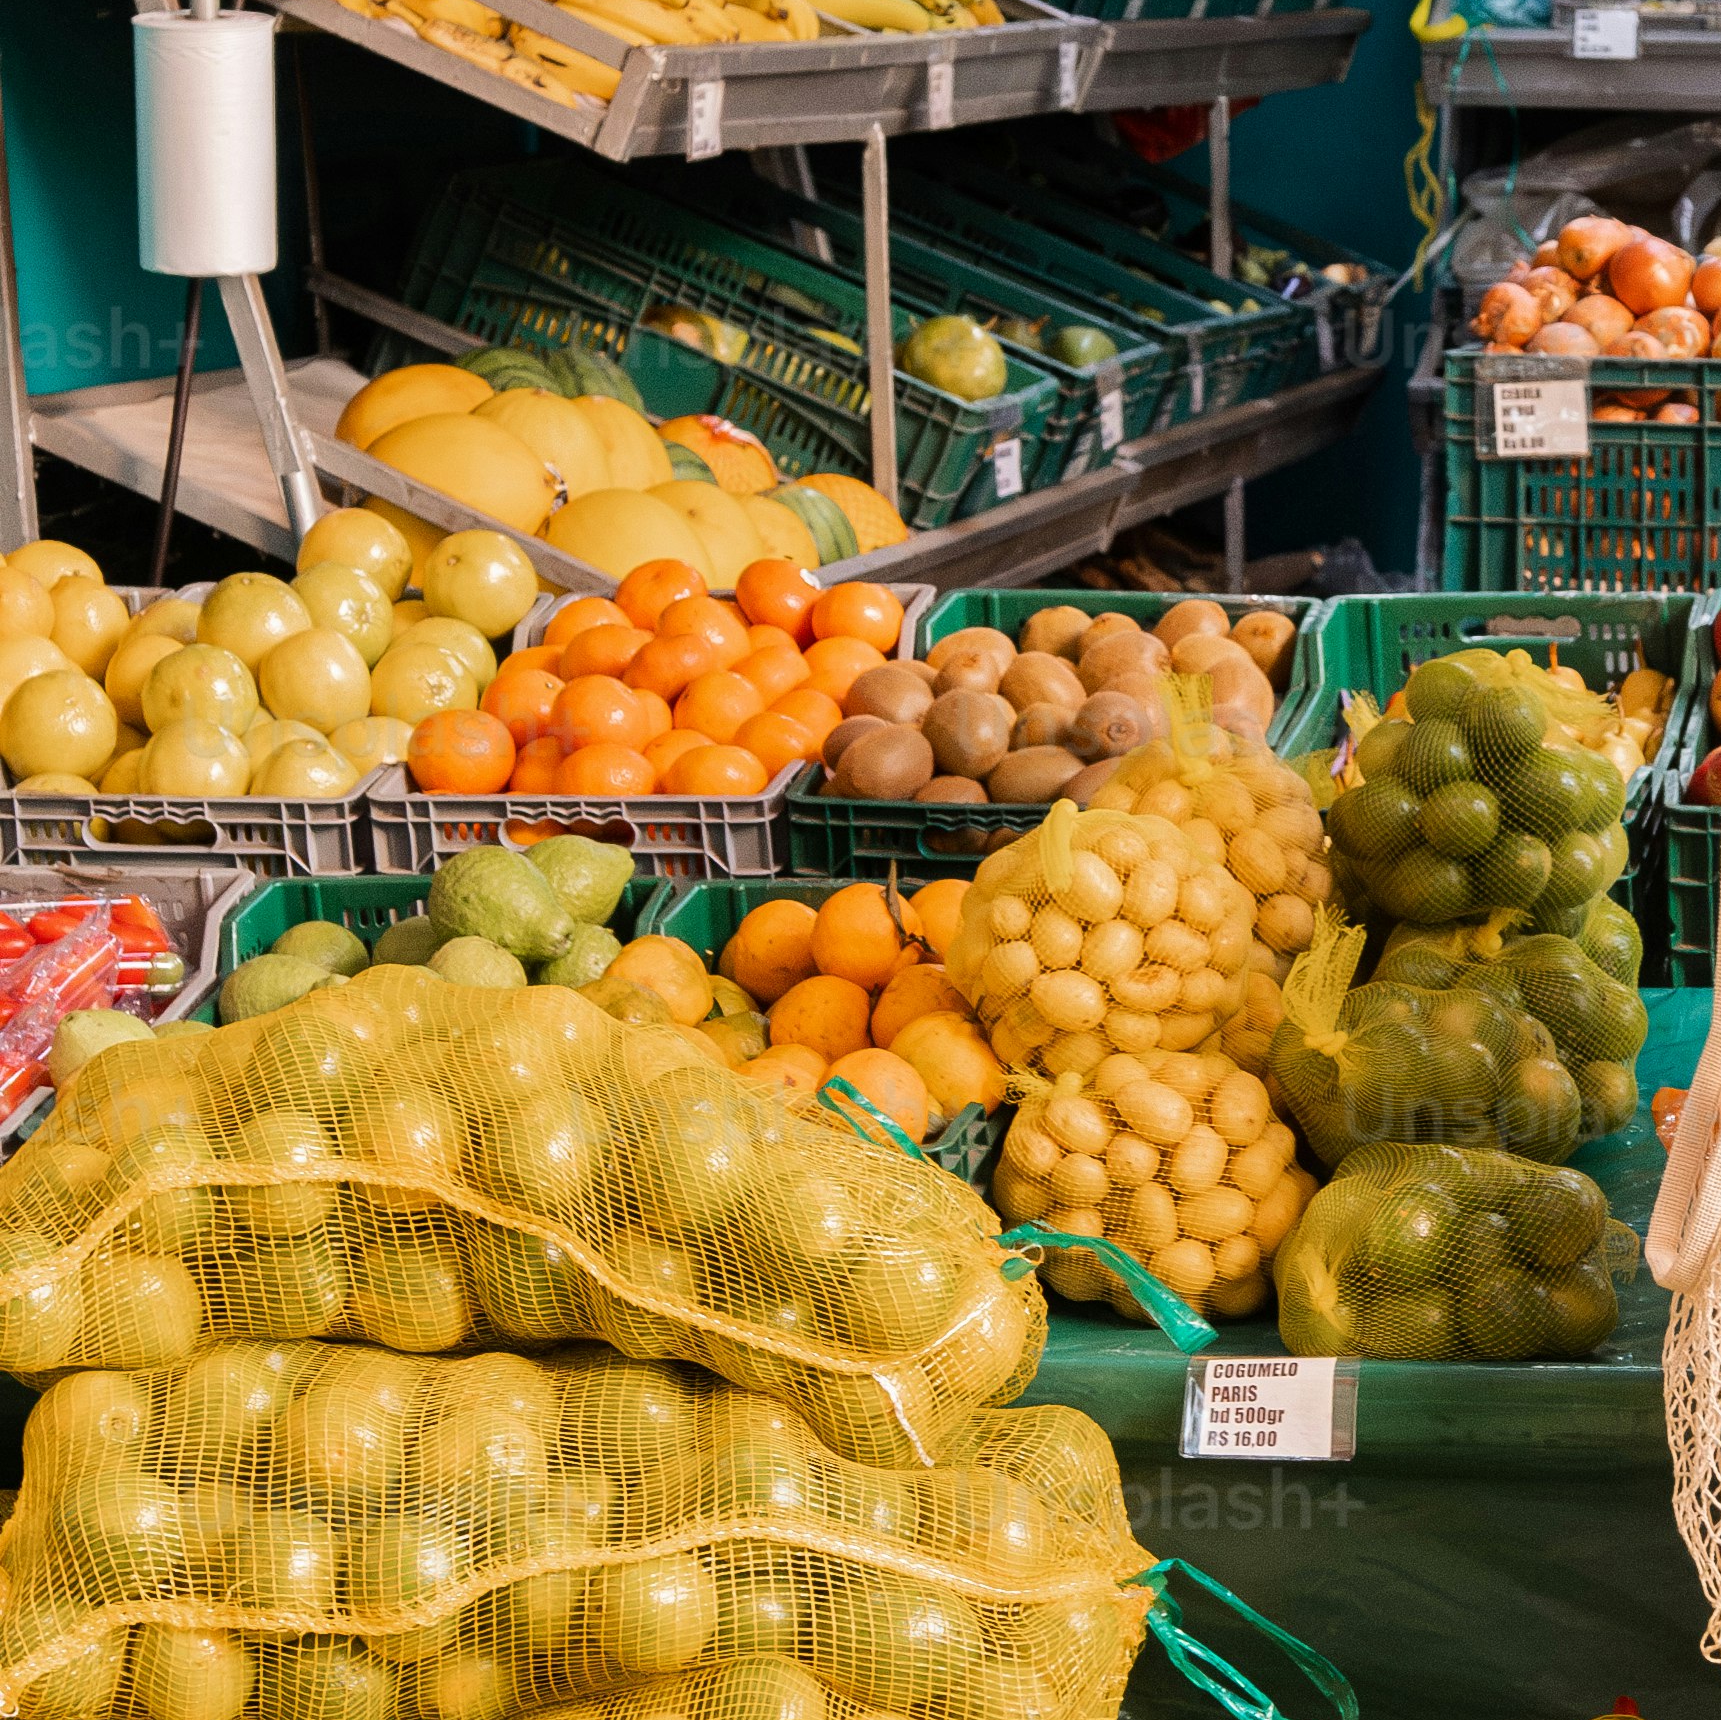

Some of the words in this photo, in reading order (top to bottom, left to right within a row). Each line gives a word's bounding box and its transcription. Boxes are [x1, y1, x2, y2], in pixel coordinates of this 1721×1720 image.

[1213, 1362, 1298, 1379] COGUMELO
[1211, 1384, 1258, 1403] PARIS
[1210, 1407, 1230, 1424] bd
[1235, 1406, 1285, 1426] 500gr
[1207, 1430, 1229, 1447] R$
[1234, 1430, 1278, 1449] 16,00
